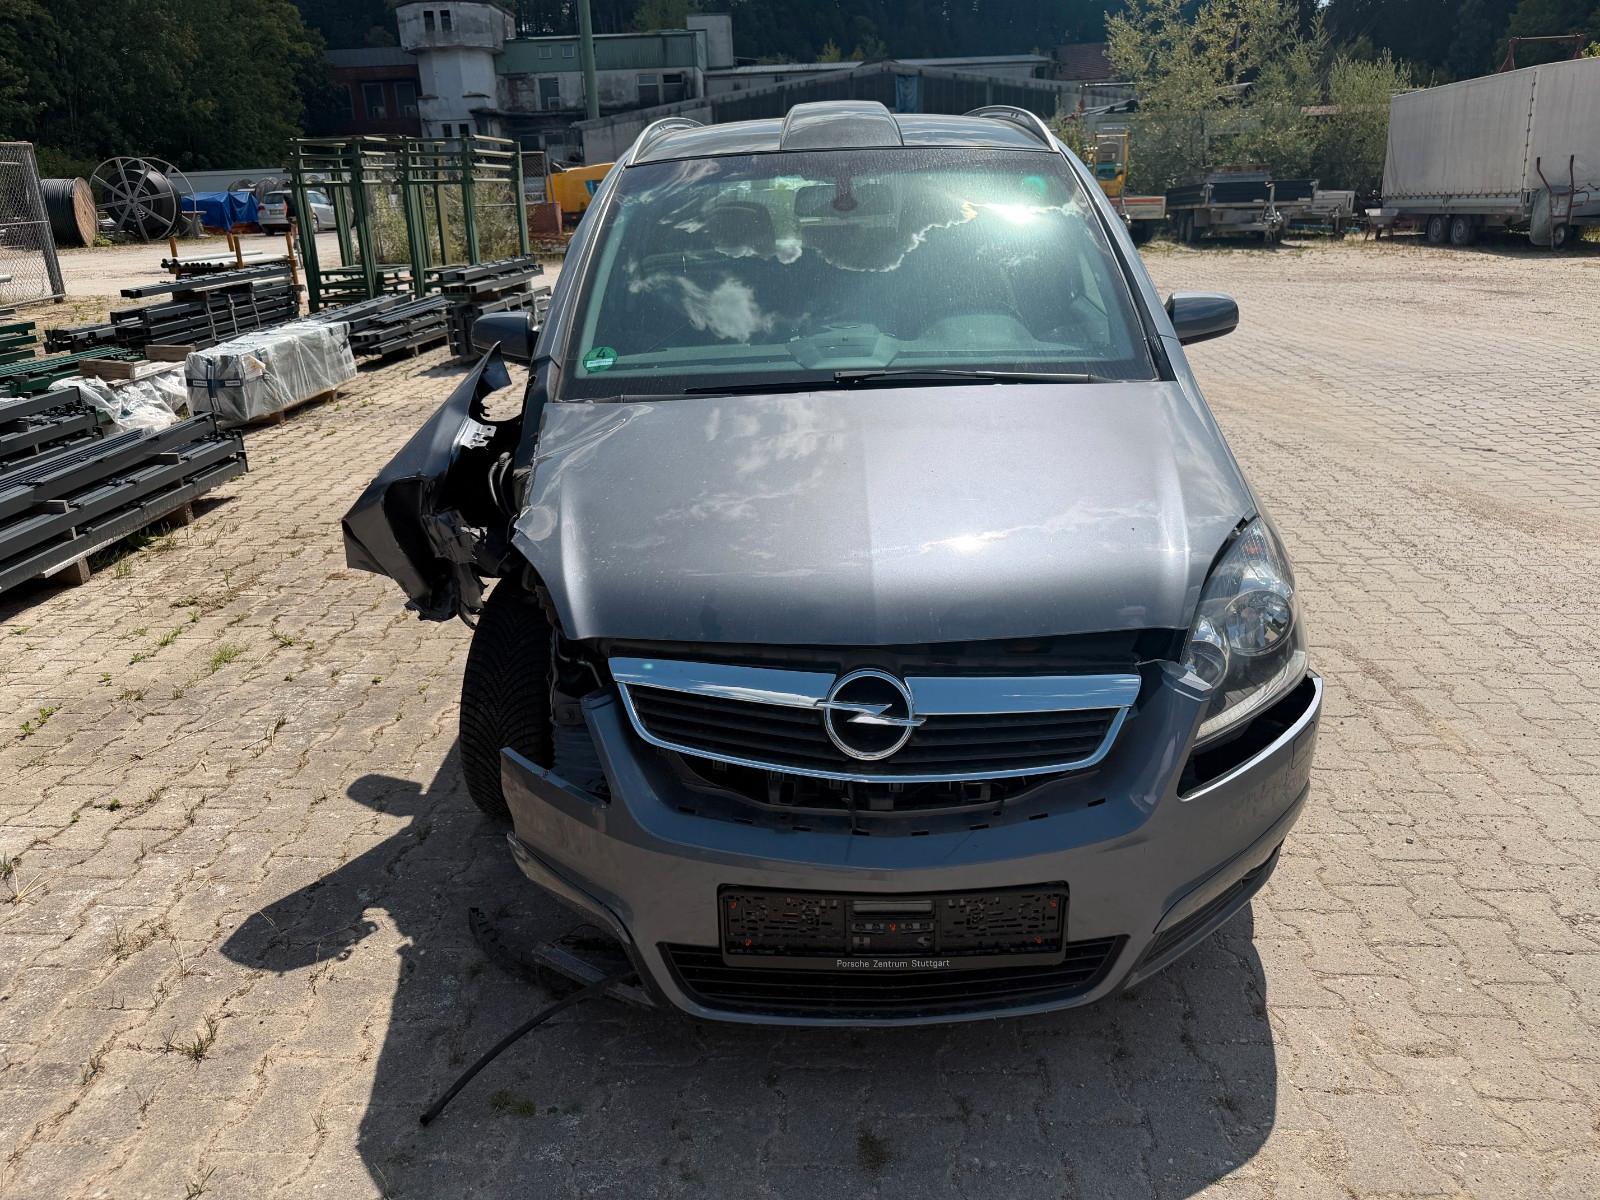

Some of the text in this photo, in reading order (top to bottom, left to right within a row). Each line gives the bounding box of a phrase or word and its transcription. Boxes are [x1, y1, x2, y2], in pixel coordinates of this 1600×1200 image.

[596, 347, 606, 359] 4
[836, 959, 950, 969] Porsche Zentrum Stuttgart
